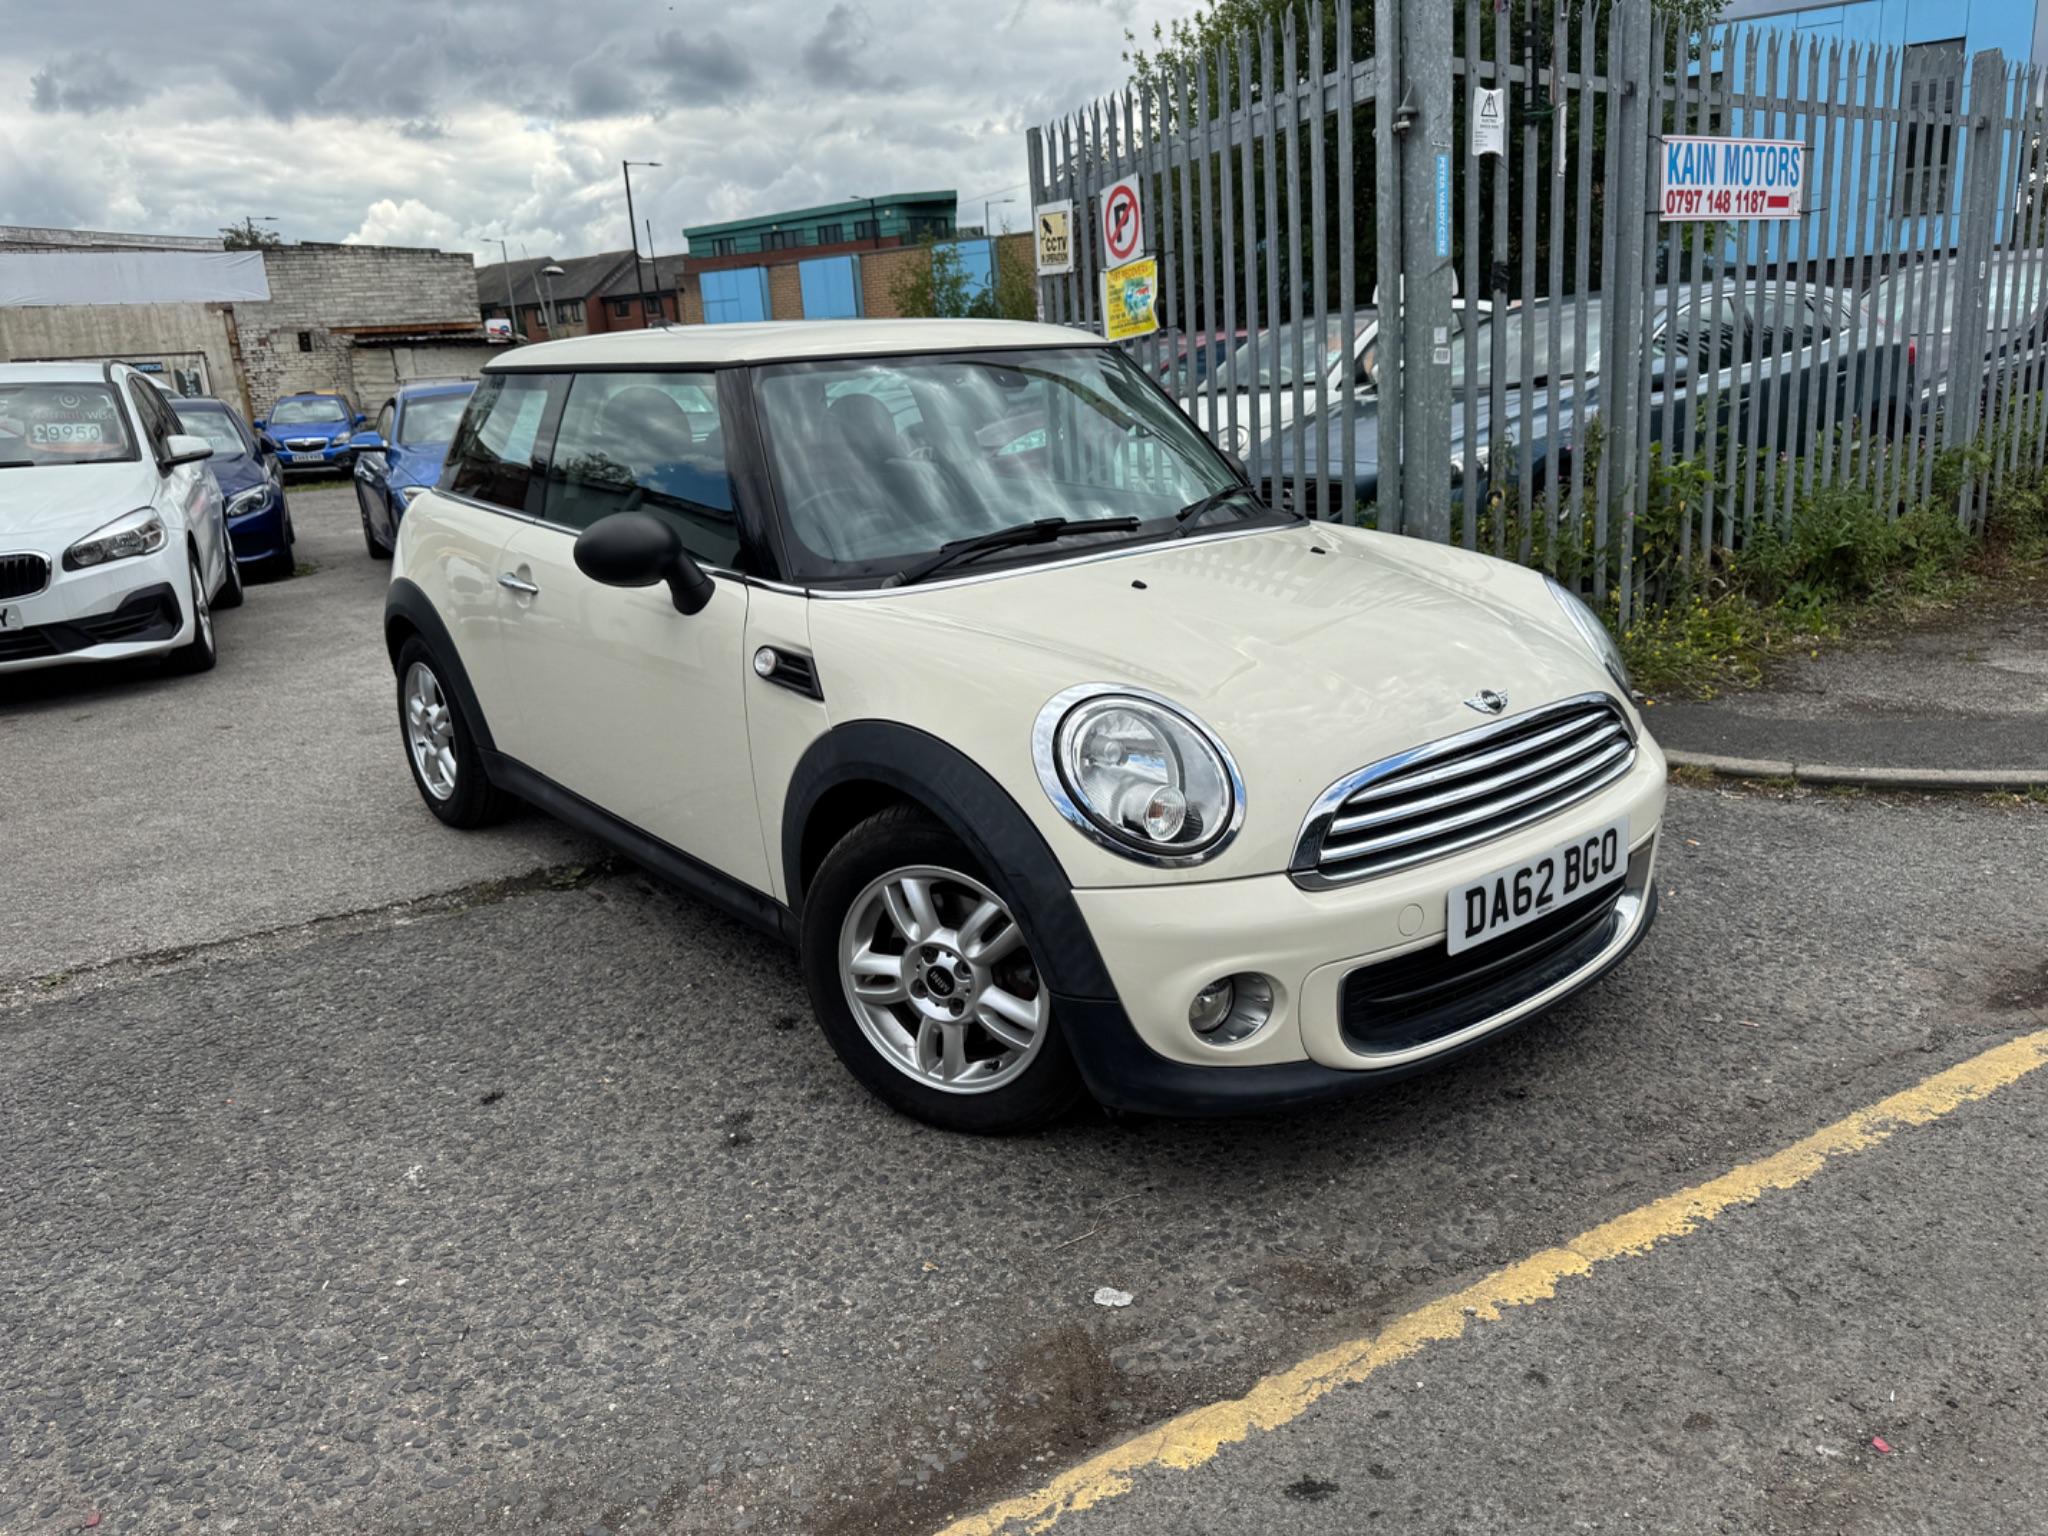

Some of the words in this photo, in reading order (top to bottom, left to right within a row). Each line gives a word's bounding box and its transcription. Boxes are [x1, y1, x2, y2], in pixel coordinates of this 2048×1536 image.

[1667, 142, 1716, 186] KAIN
[1723, 144, 1801, 187] MOTORS
[1666, 189, 1703, 215] 0797
[1707, 189, 1731, 214] 148
[1735, 190, 1767, 214] 1187
[1046, 235, 1067, 252] CCTV
[33, 424, 101, 442] £9950
[1465, 857, 1554, 939] DA62
[1563, 828, 1617, 895] BGO
